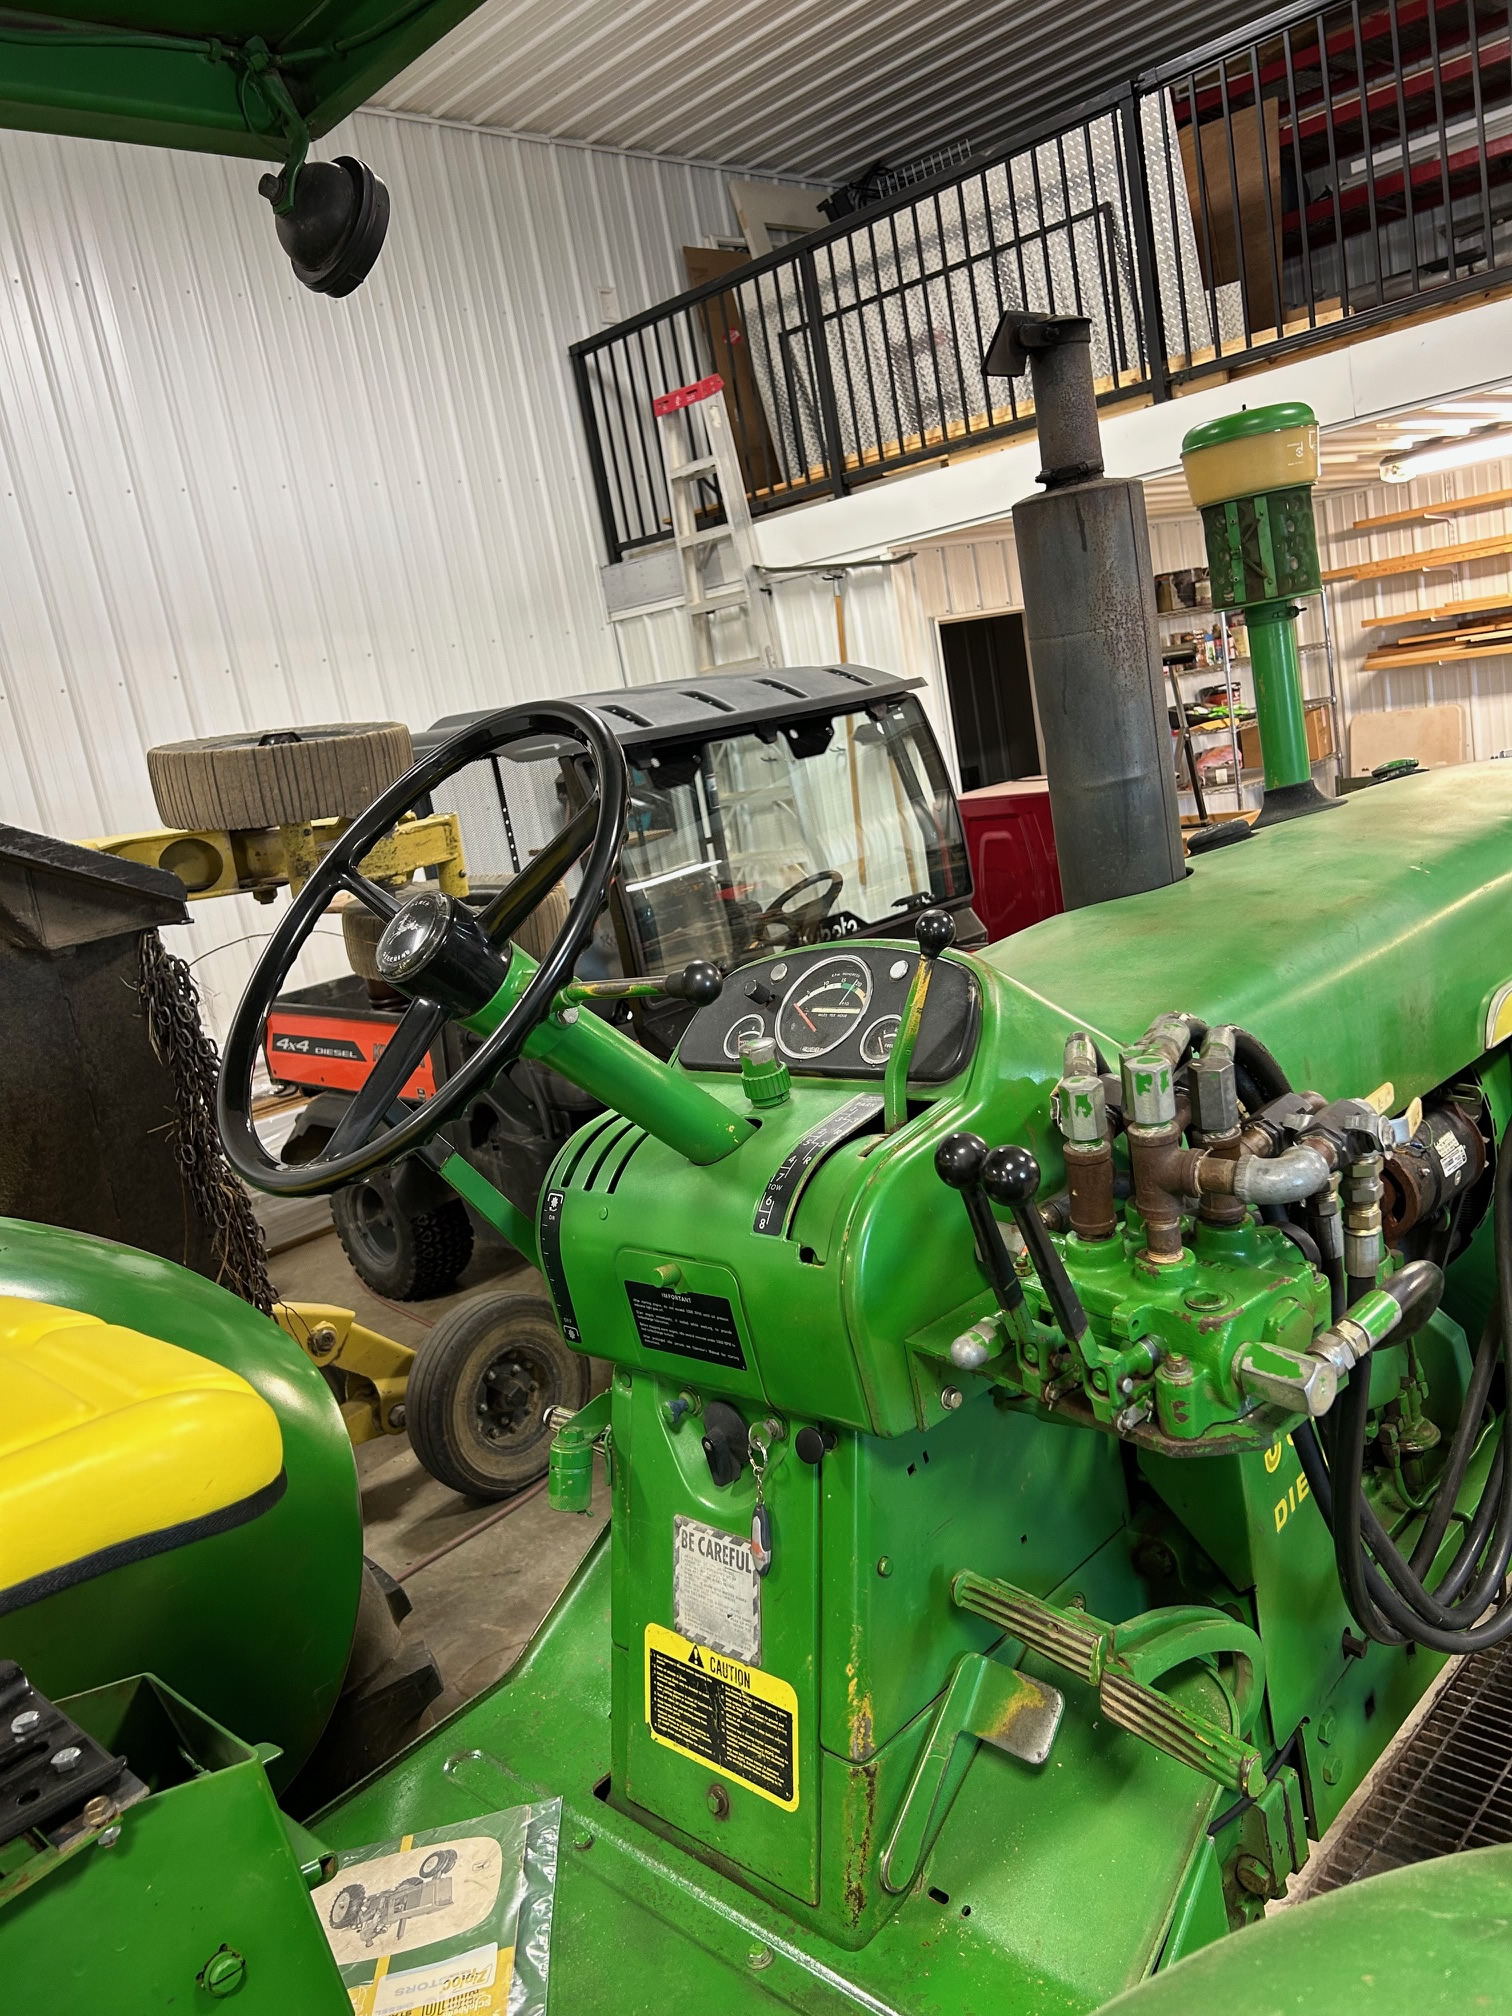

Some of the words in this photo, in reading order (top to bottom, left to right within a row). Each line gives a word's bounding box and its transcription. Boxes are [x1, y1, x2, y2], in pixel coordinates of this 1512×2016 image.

[276, 1037, 310, 1053] 4x4
[314, 1046, 358, 1059] DIESEL
[788, 1155, 797, 1163] 4
[802, 1156, 812, 1165] R
[768, 1183, 783, 1191] TOW
[765, 1195, 772, 1206] 6
[758, 1218, 766, 1230] 8
[660, 1292, 692, 1304] IMPORTANT
[681, 1528, 695, 1552] BE
[697, 1536, 752, 1575] CAREFUL
[710, 1656, 751, 1690] CAUTION
[442, 1967, 488, 1991] Ziploc
